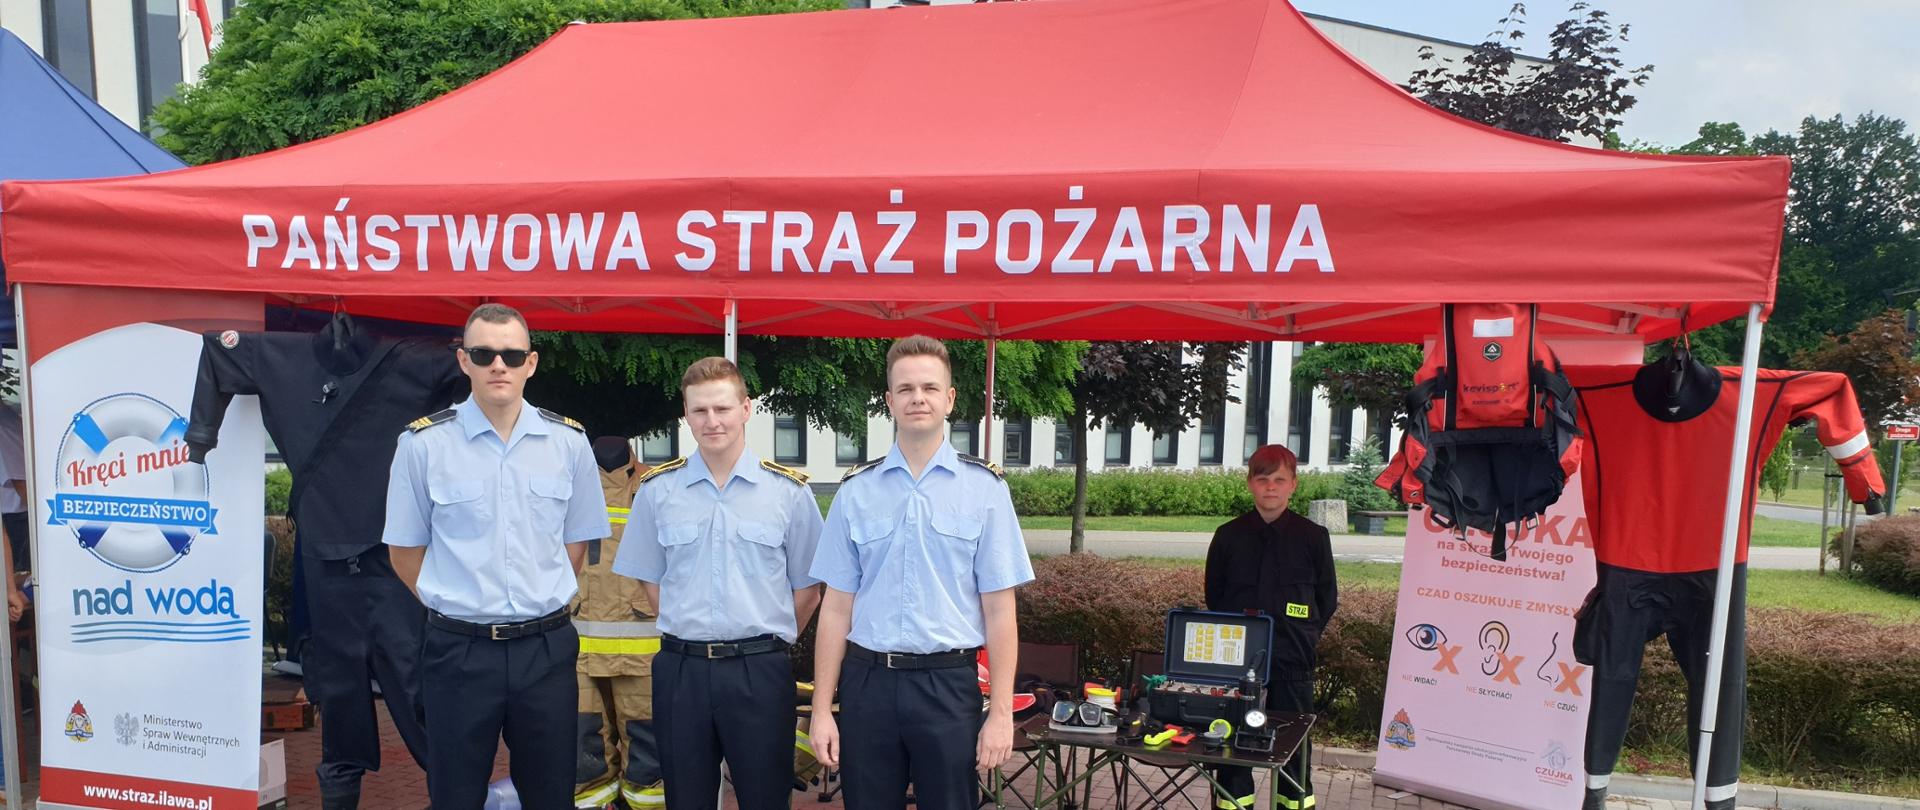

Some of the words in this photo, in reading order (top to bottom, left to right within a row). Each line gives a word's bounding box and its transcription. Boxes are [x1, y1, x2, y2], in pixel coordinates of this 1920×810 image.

[242, 197, 651, 272] PAŃSTWOWA
[674, 189, 916, 273] STRAŻ
[944, 186, 1335, 274] POŻARNA
[67, 452, 127, 487] Kręci
[137, 439, 190, 473] mnie
[62, 499, 207, 522] BEZPIECZEŃSTWO
[1437, 540, 1455, 551] na
[1460, 541, 1494, 555] stra
[1511, 546, 1574, 564] Twojego
[1441, 556, 1566, 582] bezpieczeństwa!
[73, 579, 134, 616] nad
[145, 579, 240, 619] wodą
[1416, 586, 1450, 600] CZAD
[1454, 591, 1523, 610] OSZUKUJE
[143, 714, 203, 730] Ministerstwo
[143, 727, 171, 740] Spraw
[174, 730, 240, 748] Wewnętrznych
[148, 741, 207, 758] Administracji
[1535, 766, 1574, 781] CZUJKA
[84, 785, 212, 810] www.straz.ilawa.pl
